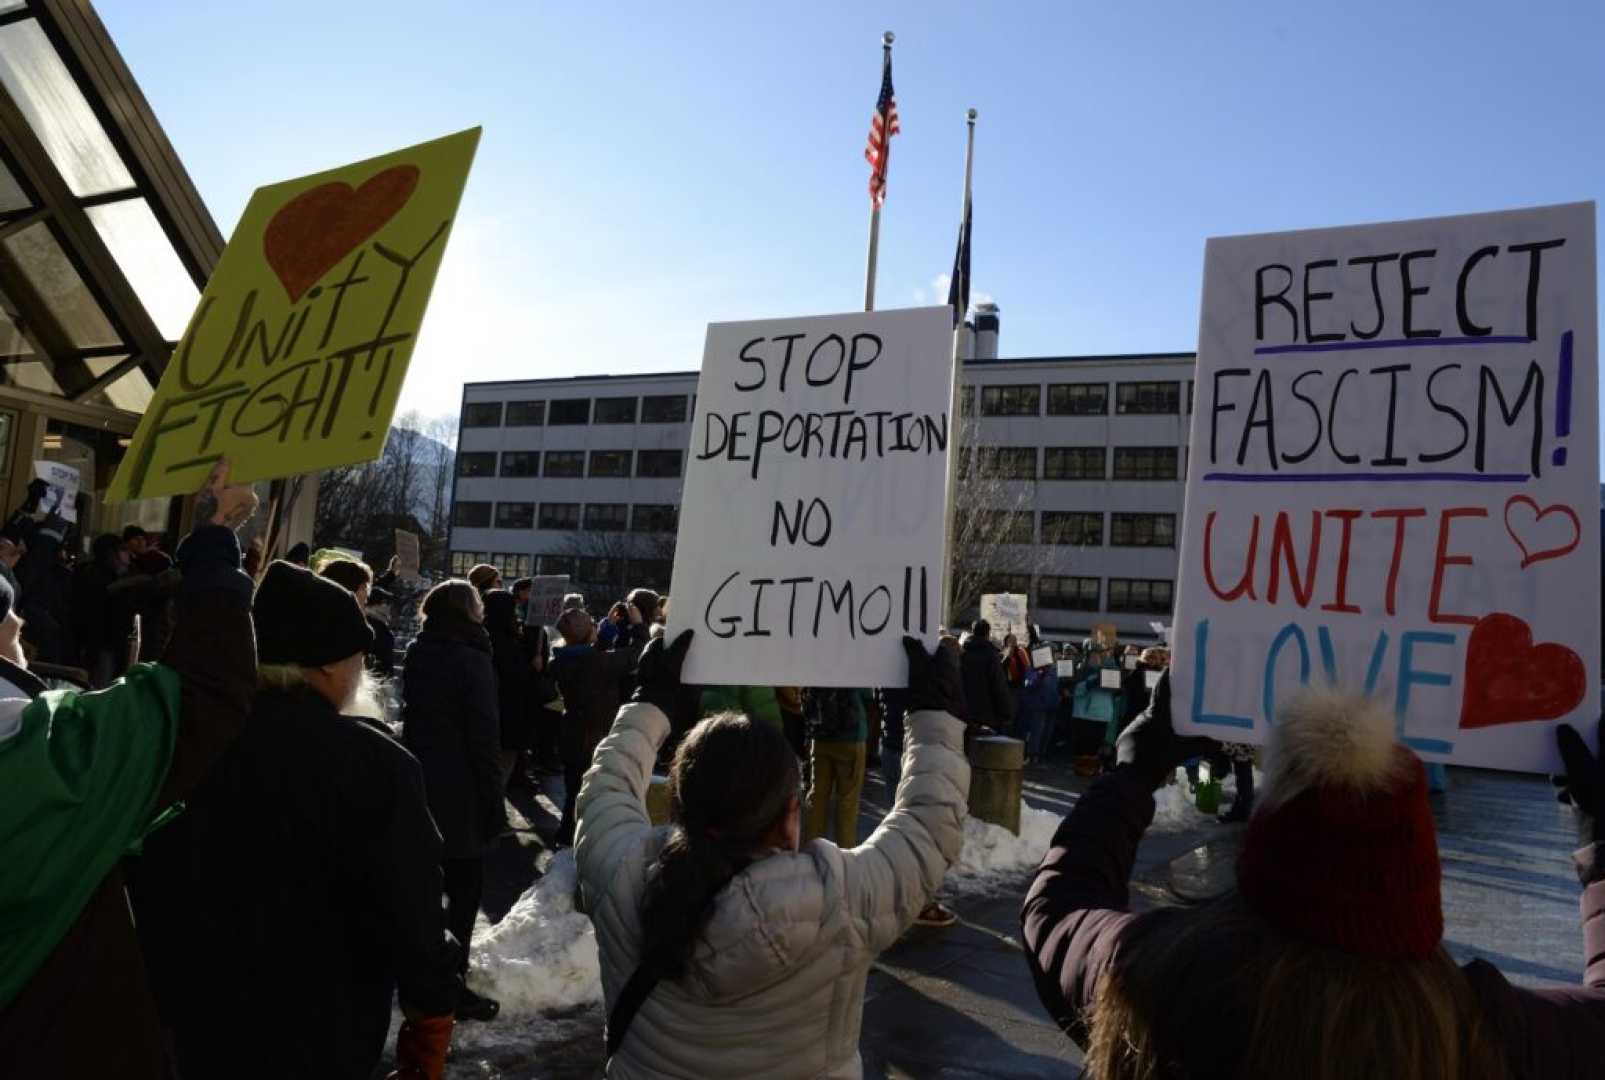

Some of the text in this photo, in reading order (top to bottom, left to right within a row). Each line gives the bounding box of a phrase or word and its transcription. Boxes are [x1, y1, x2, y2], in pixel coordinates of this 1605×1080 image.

[1254, 238, 1567, 344] REJECT
[127, 333, 412, 500] FIGHT!
[734, 333, 883, 405] STOP
[1210, 330, 1574, 478] FASCISM!
[696, 410, 948, 480] DEPORTATION
[770, 497, 833, 548] NO
[1203, 507, 1489, 625] UNITE
[1191, 617, 1457, 755] LOVE
